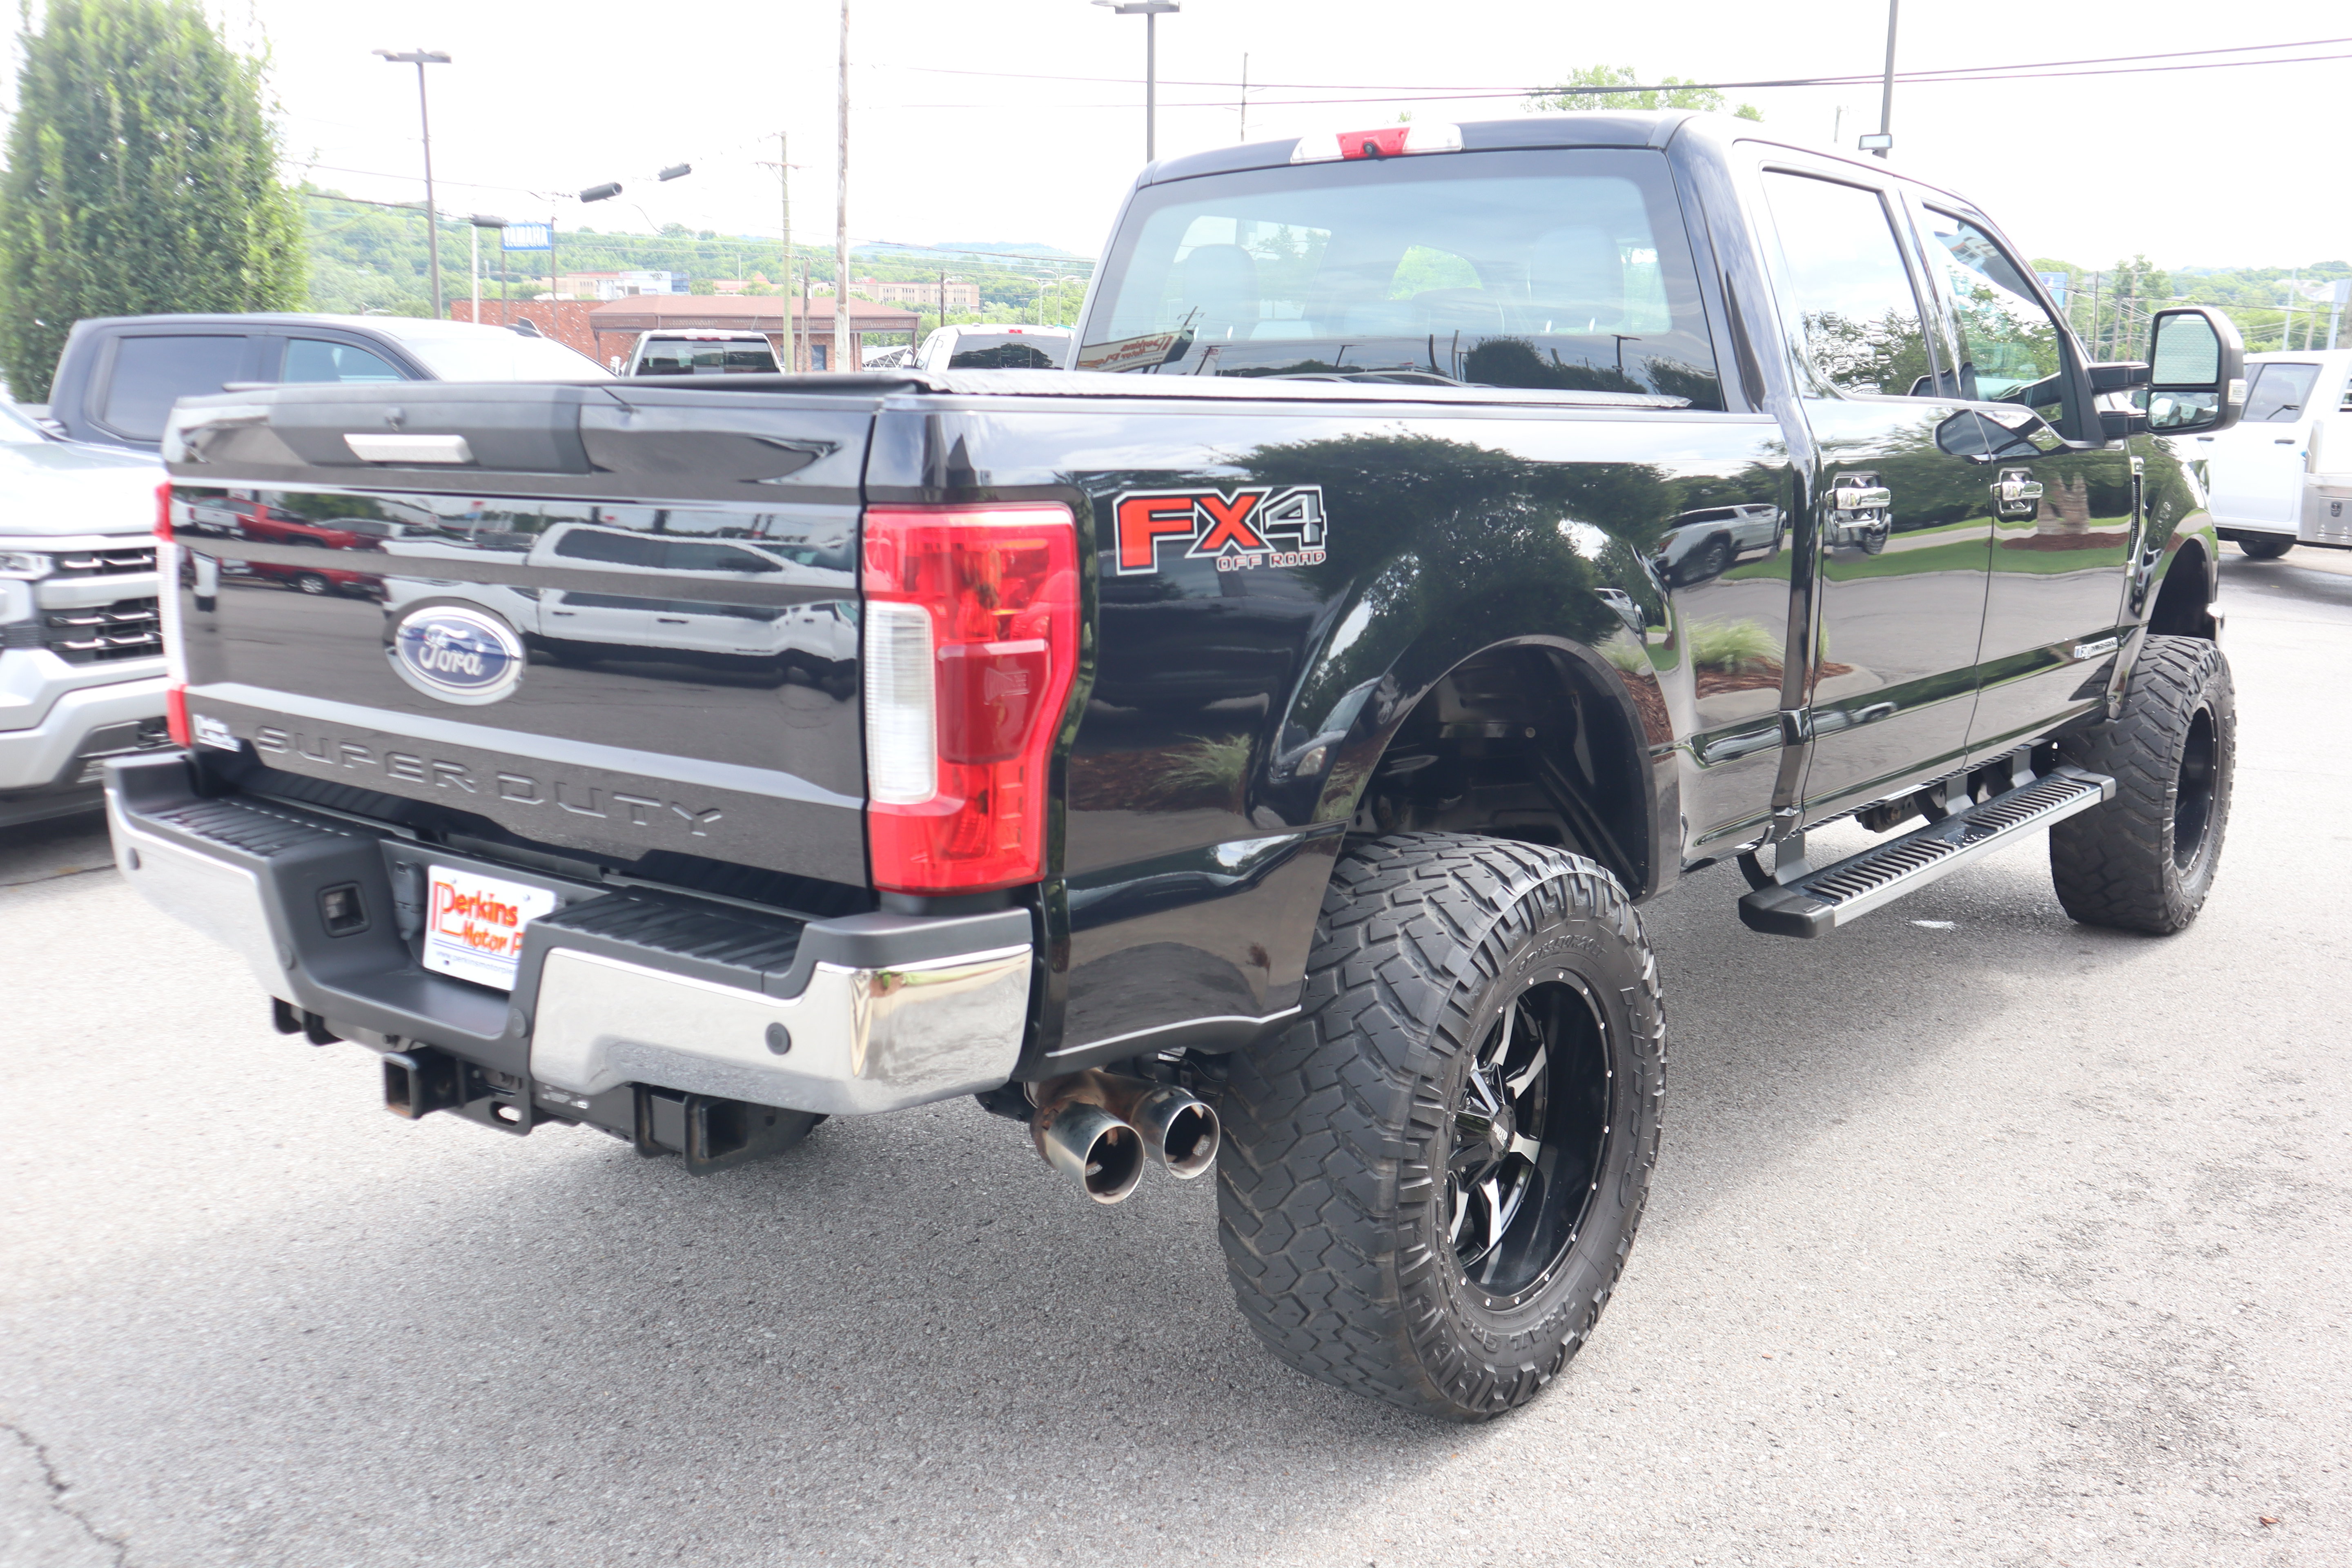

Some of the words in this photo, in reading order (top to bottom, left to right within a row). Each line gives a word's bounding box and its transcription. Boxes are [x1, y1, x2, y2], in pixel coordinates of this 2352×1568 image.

[502, 226, 549, 247] YAMAHA
[1113, 485, 1327, 575] FX4
[1216, 554, 1262, 572] OFF
[1269, 550, 1326, 568] ROAD
[419, 624, 485, 676] Ford
[256, 725, 477, 793] SUPER
[497, 771, 723, 837] DUTY
[431, 881, 518, 934] Perkins
[462, 920, 508, 953] Motor
[1492, 1121, 1508, 1141] MOTO
